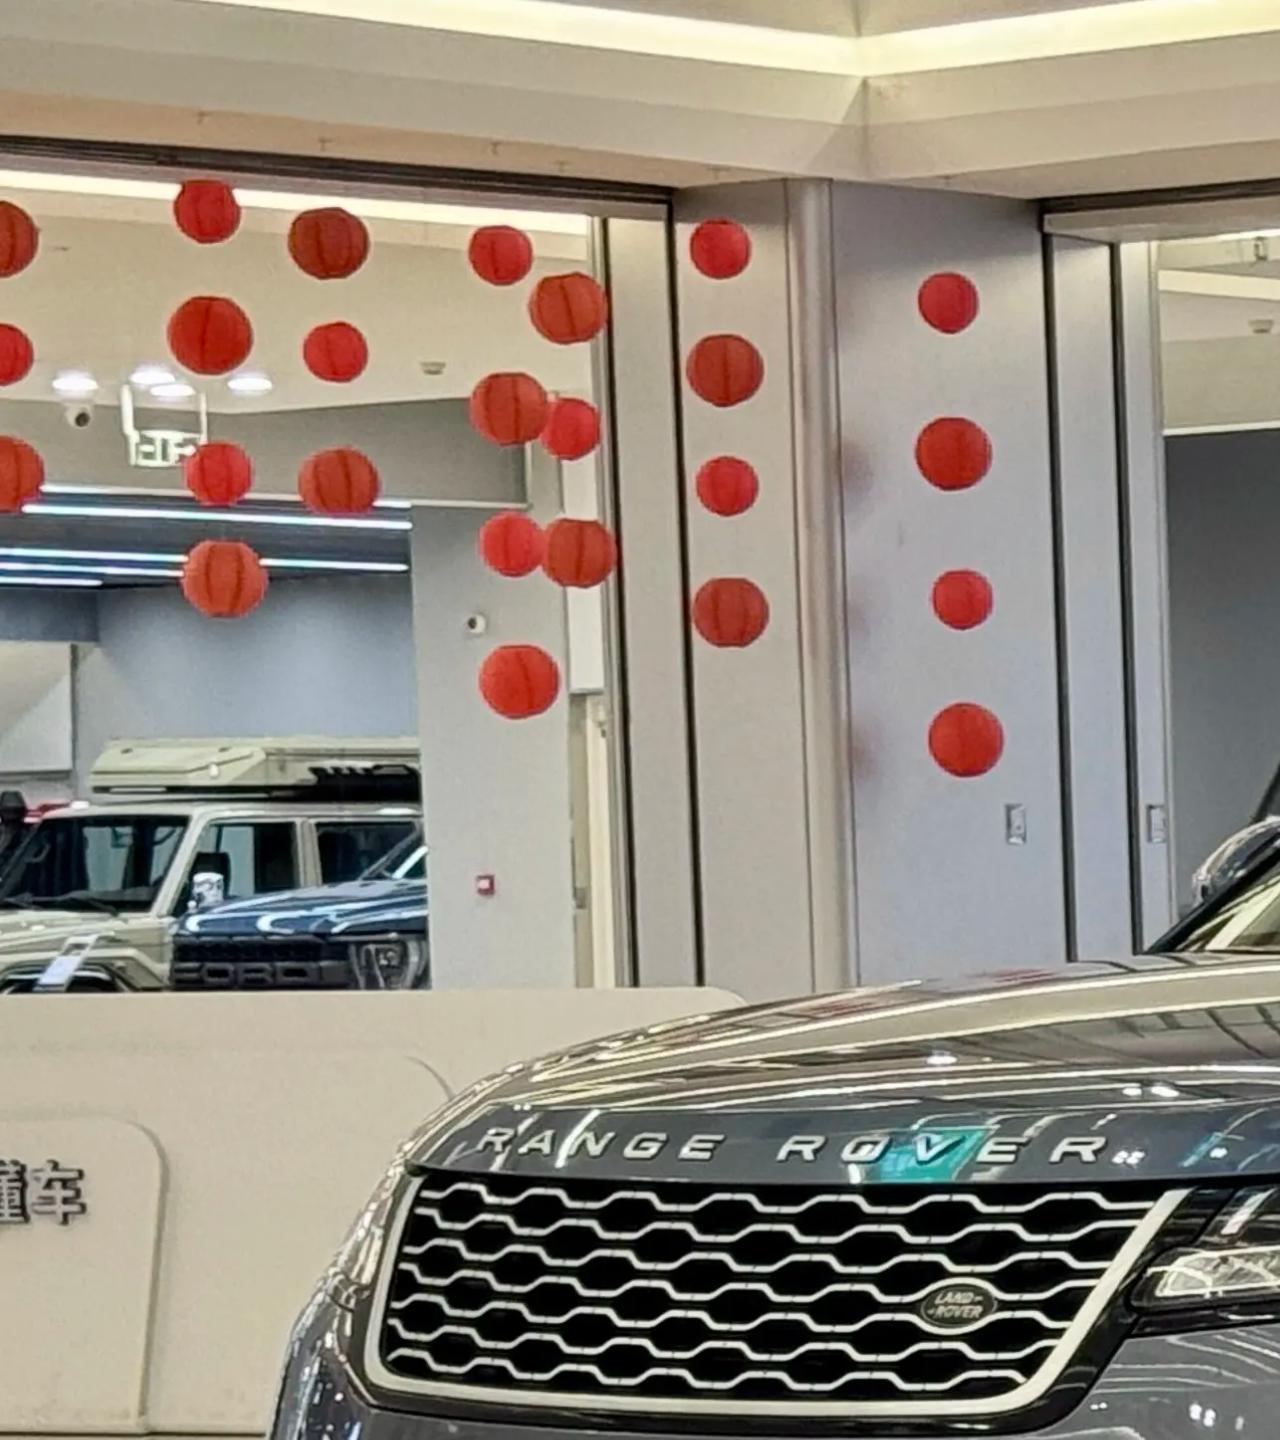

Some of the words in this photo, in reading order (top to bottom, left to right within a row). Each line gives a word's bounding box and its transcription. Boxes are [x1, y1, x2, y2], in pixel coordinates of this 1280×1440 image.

[172, 961, 321, 987] FORD
[476, 1126, 726, 1162] RANGE
[775, 1132, 1108, 1166] ROVER
